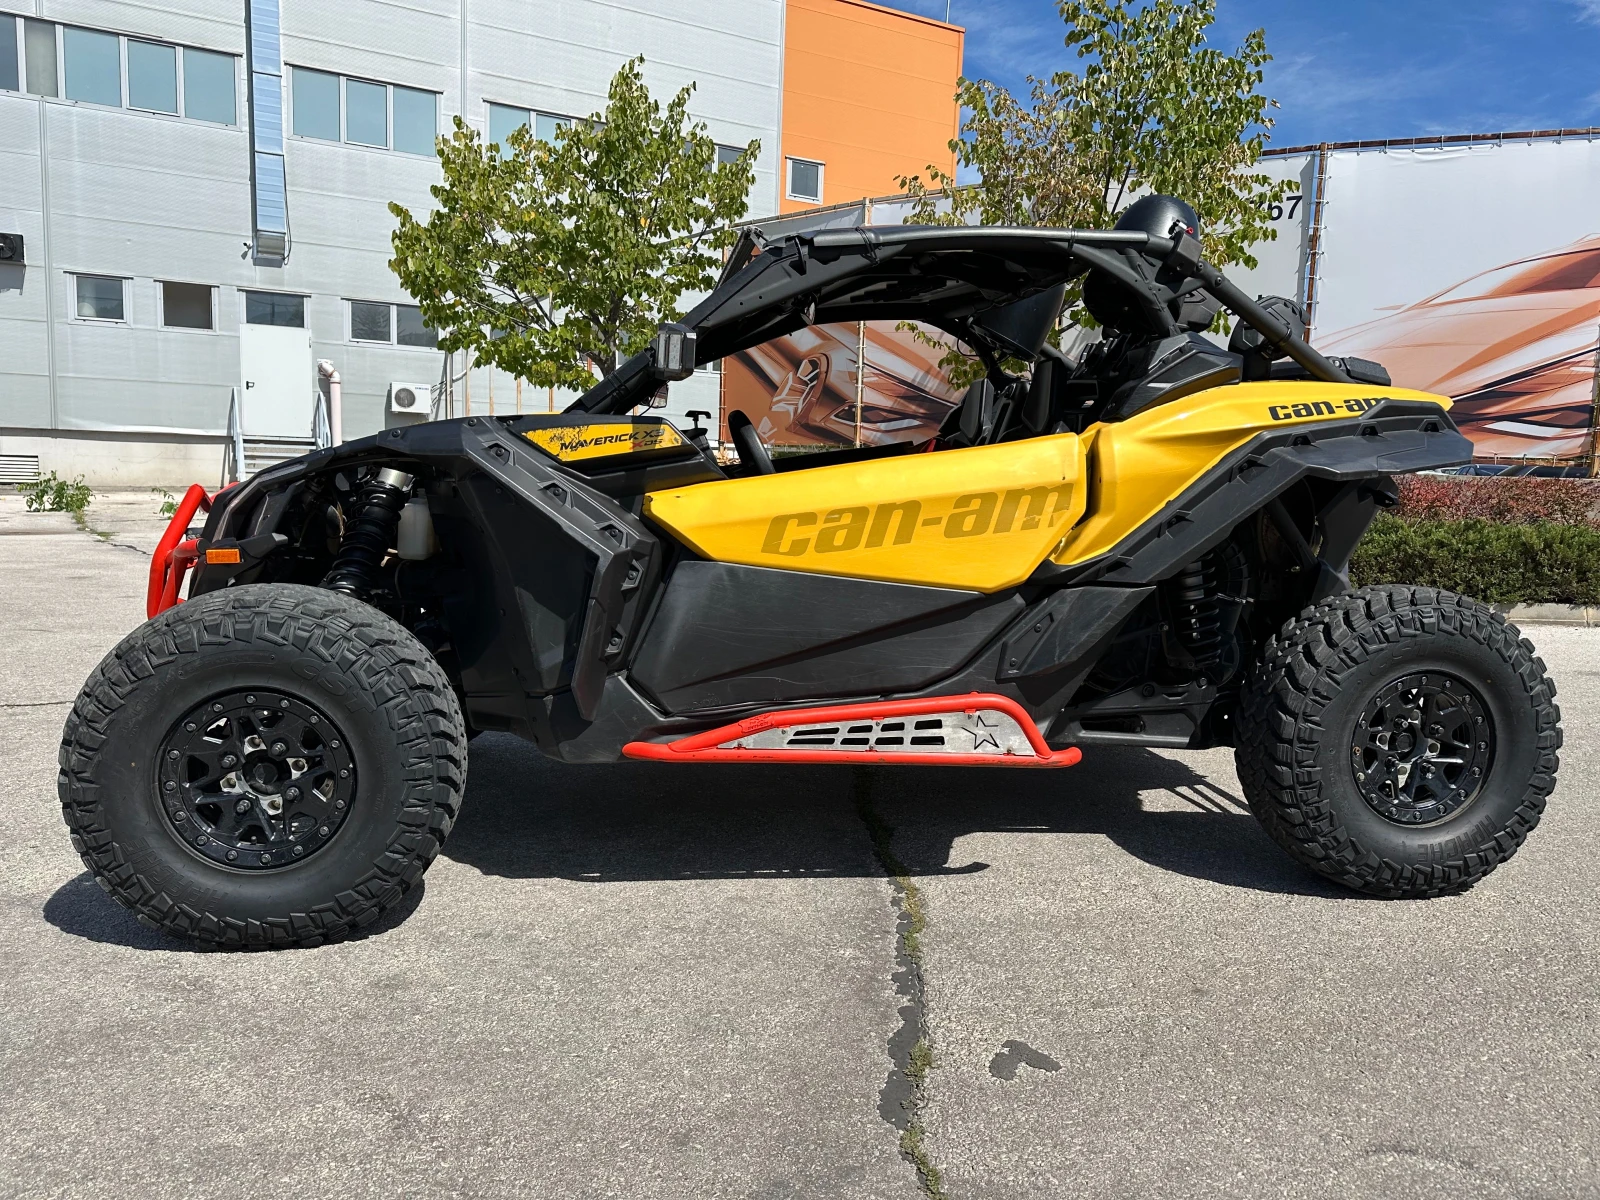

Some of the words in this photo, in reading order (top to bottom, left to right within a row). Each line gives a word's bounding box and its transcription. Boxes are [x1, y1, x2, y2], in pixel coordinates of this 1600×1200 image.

[560, 432, 640, 452] MAVERICK
[641, 428, 665, 440] X3
[761, 483, 1074, 557] can-am
[290, 657, 377, 714] CST
[1417, 815, 1498, 864] APACHE
[120, 837, 228, 912] APACHE
